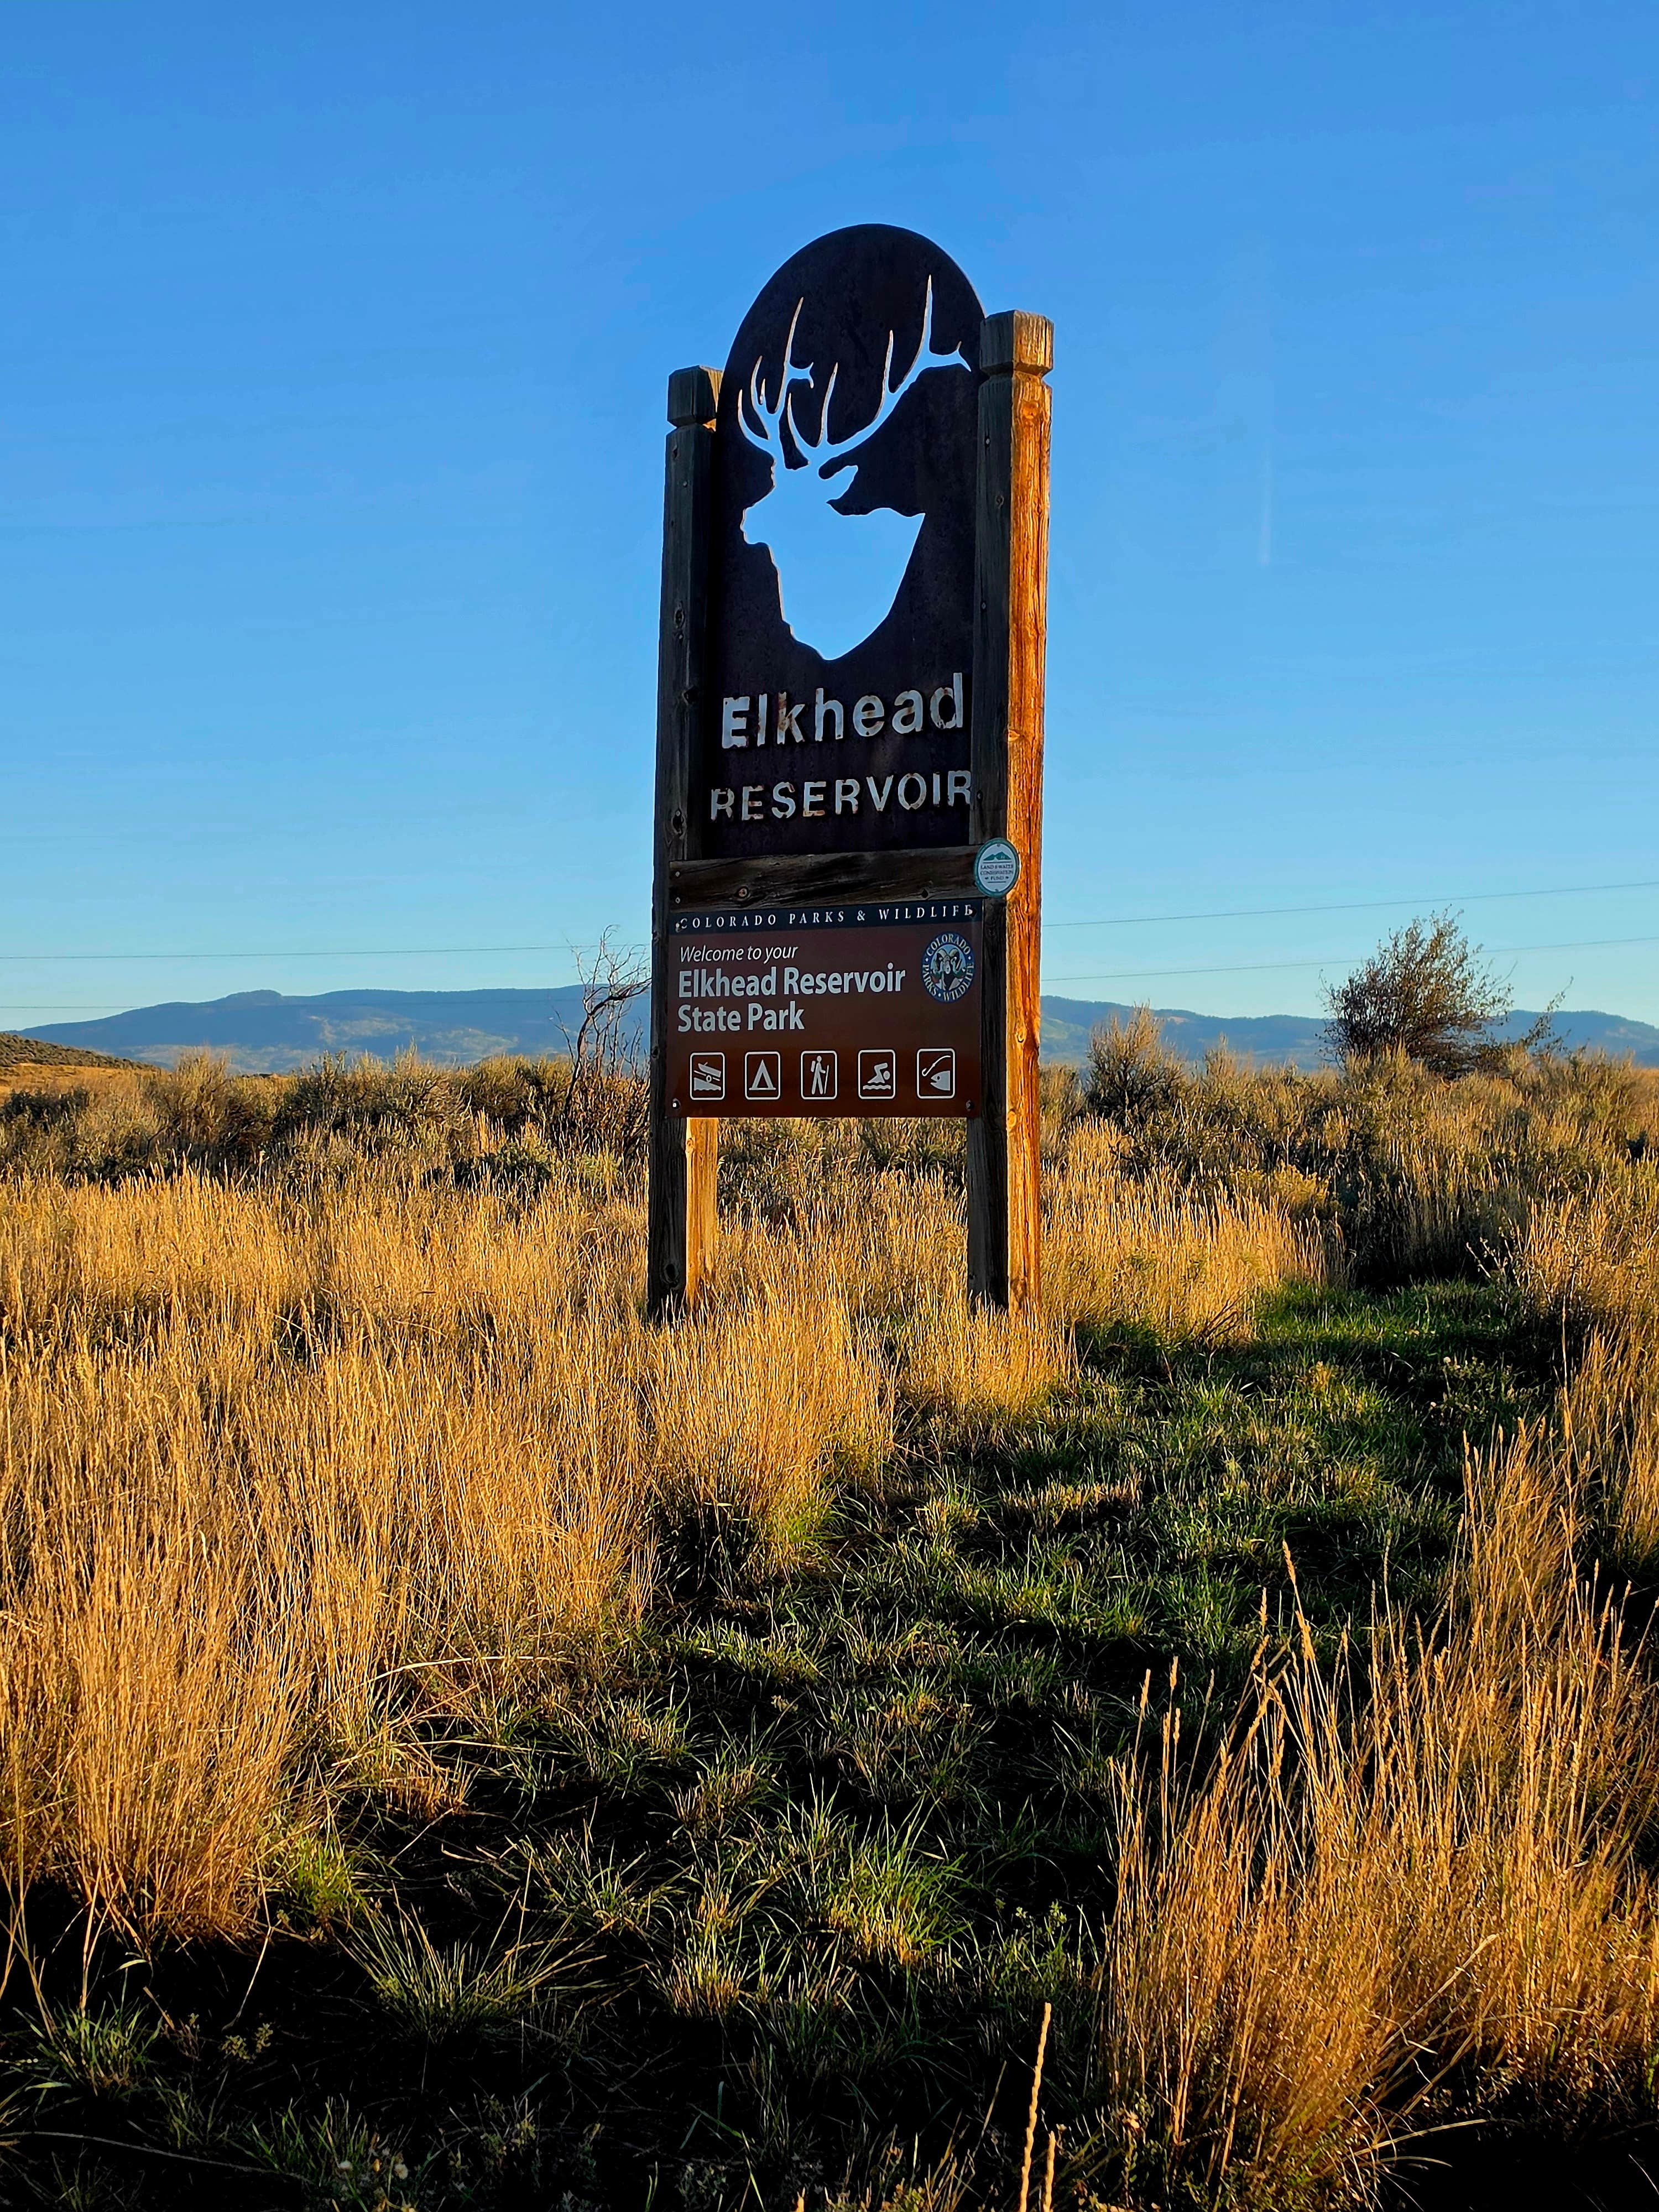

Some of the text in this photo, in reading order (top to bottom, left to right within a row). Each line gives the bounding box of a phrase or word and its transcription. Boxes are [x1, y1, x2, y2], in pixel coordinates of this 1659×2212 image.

[721, 672, 963, 749] Elkhead
[711, 770, 971, 822] RESERVOIR
[680, 905, 972, 929] COLORADO PARKS & WILDLIFE
[680, 945, 799, 964] Welcome to your
[926, 933, 971, 956] COLORADO
[679, 962, 906, 997] Elkhead Reservoir
[922, 963, 974, 1001] PARKS WILDLIFE
[678, 1000, 805, 1032] State Park
